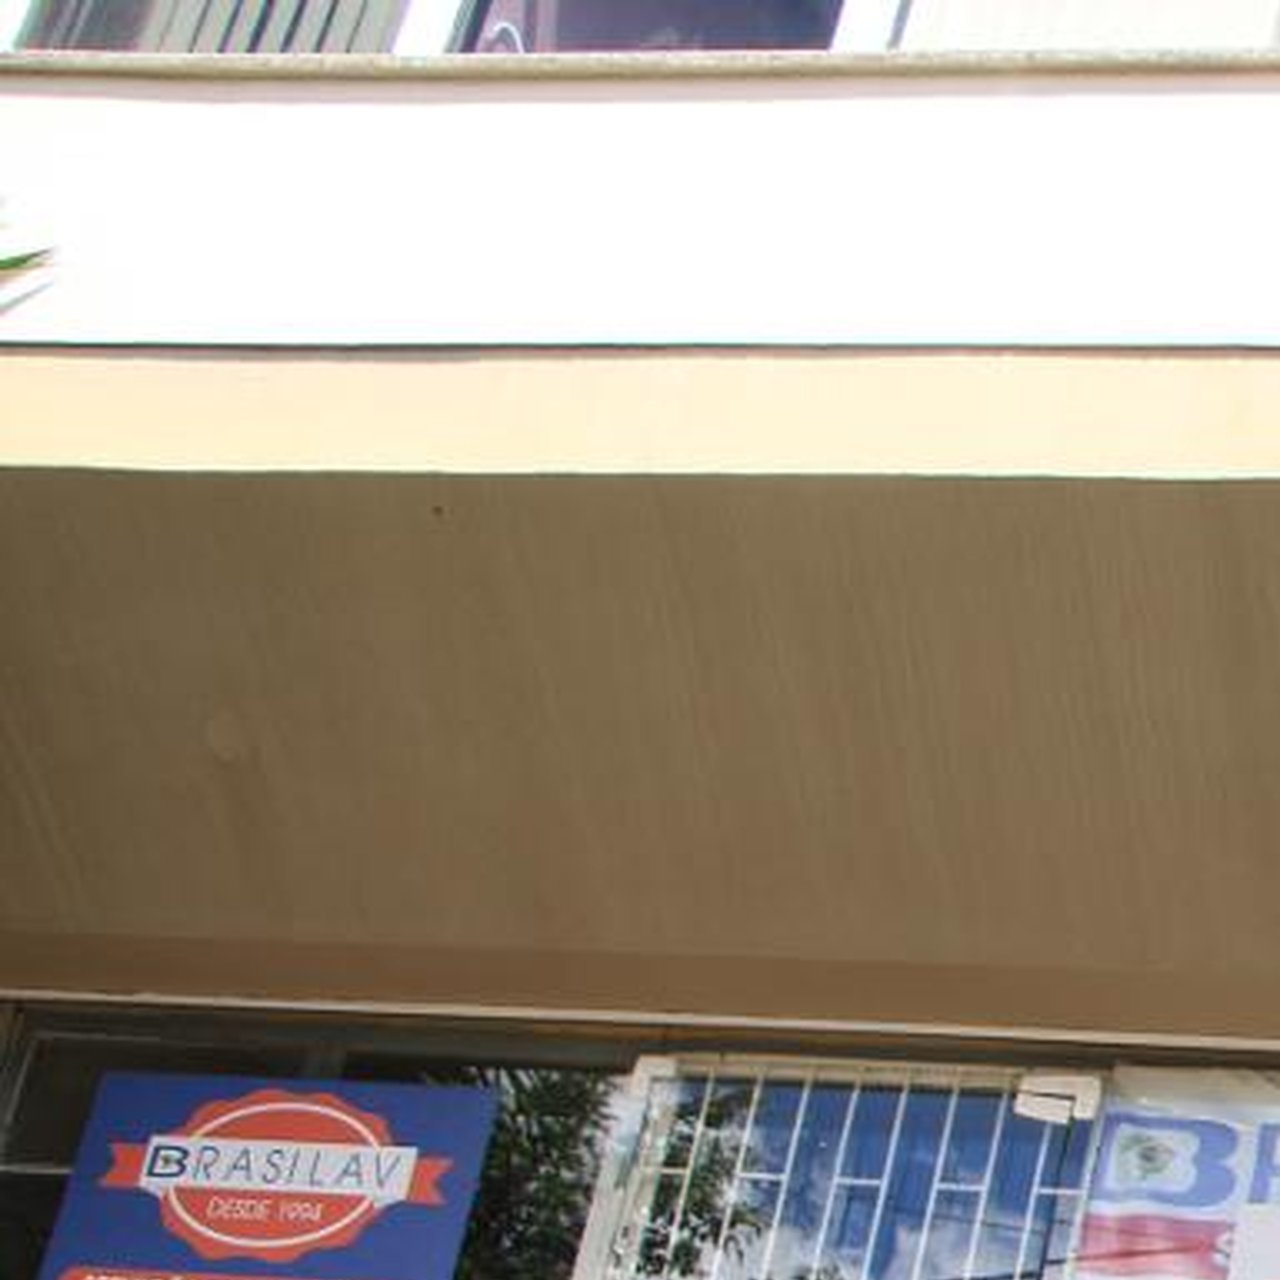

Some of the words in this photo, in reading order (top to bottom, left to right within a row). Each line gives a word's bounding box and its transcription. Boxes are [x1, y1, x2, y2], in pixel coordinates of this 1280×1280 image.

[147, 1145, 401, 1188] BRASILAV
[206, 1196, 272, 1221] DESDE
[279, 1203, 323, 1222] 1994
